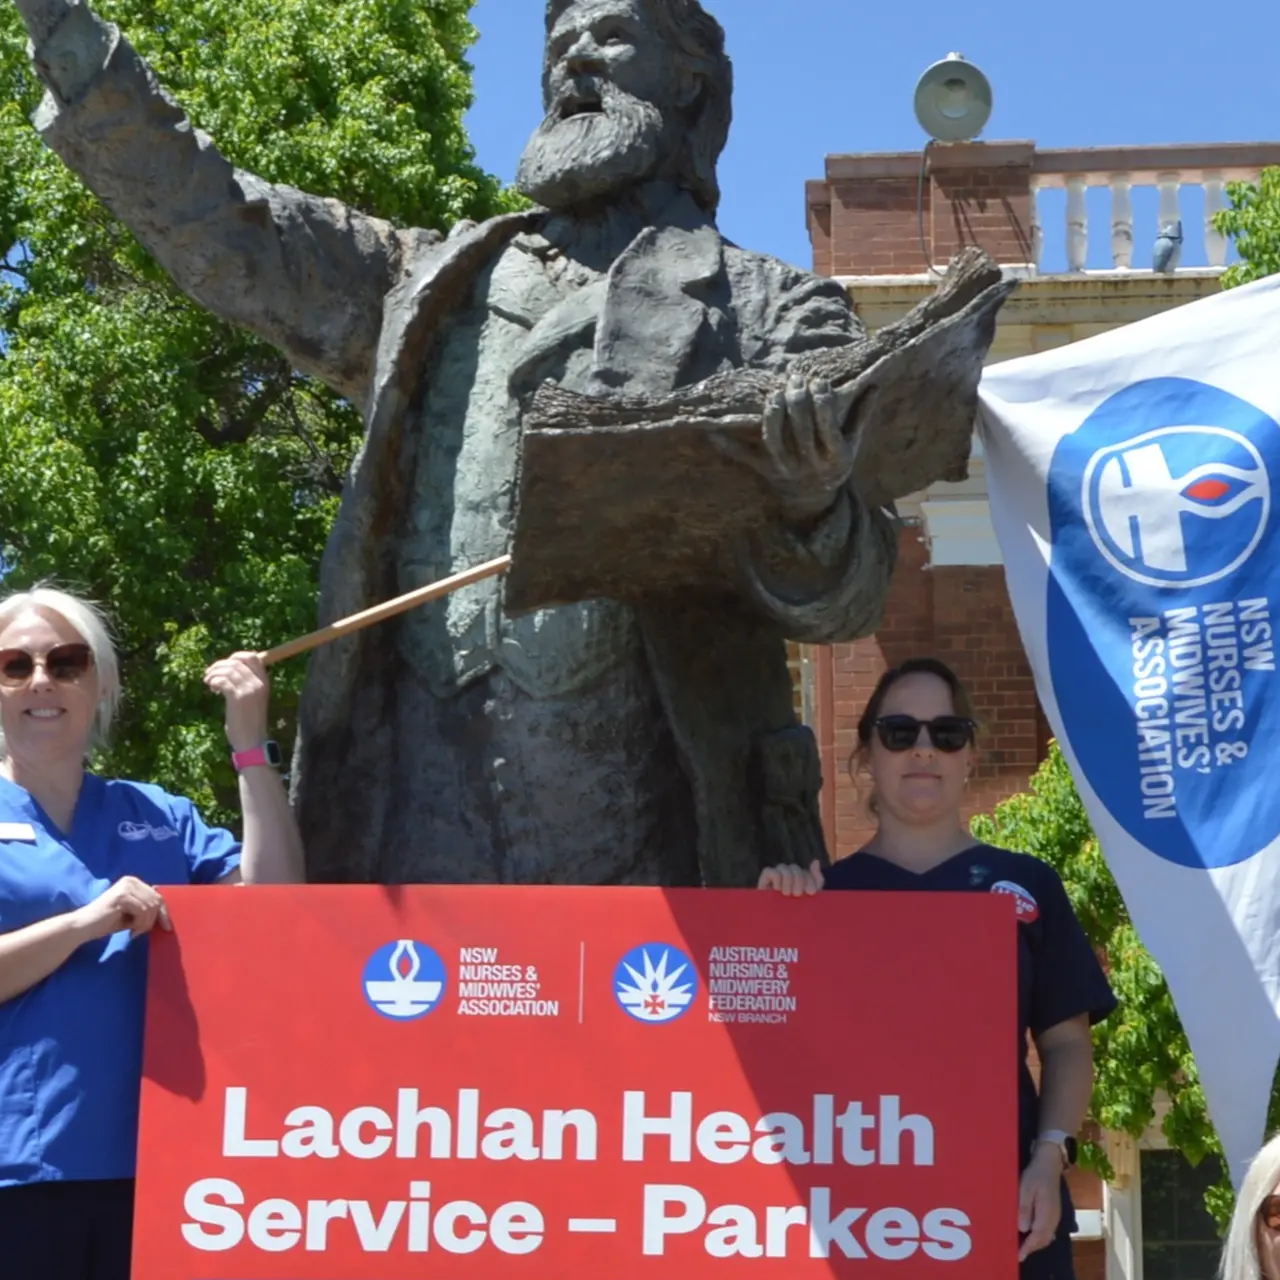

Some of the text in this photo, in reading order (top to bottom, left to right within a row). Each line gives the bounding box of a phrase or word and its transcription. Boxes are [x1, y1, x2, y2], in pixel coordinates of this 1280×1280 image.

[1238, 597, 1275, 671] NSW
[1164, 606, 1211, 773] MIDWIVES'
[1202, 602, 1248, 766] NURSES &
[1128, 617, 1176, 819] ASSOCIATION
[460, 947, 497, 963] NSW
[709, 946, 798, 963] AUSTRALIAN
[459, 964, 538, 981] NURSES &
[709, 963, 789, 979] NURSING &
[709, 979, 790, 995] MIDWIFERY
[457, 999, 558, 1016] ASSOCIATION
[708, 995, 796, 1012] FEDERATION
[707, 1012, 787, 1024] NSW BRANCH
[222, 1086, 935, 1166] Lachlan Health
[180, 1177, 545, 1255] Service
[642, 1183, 973, 1261] Parkes
